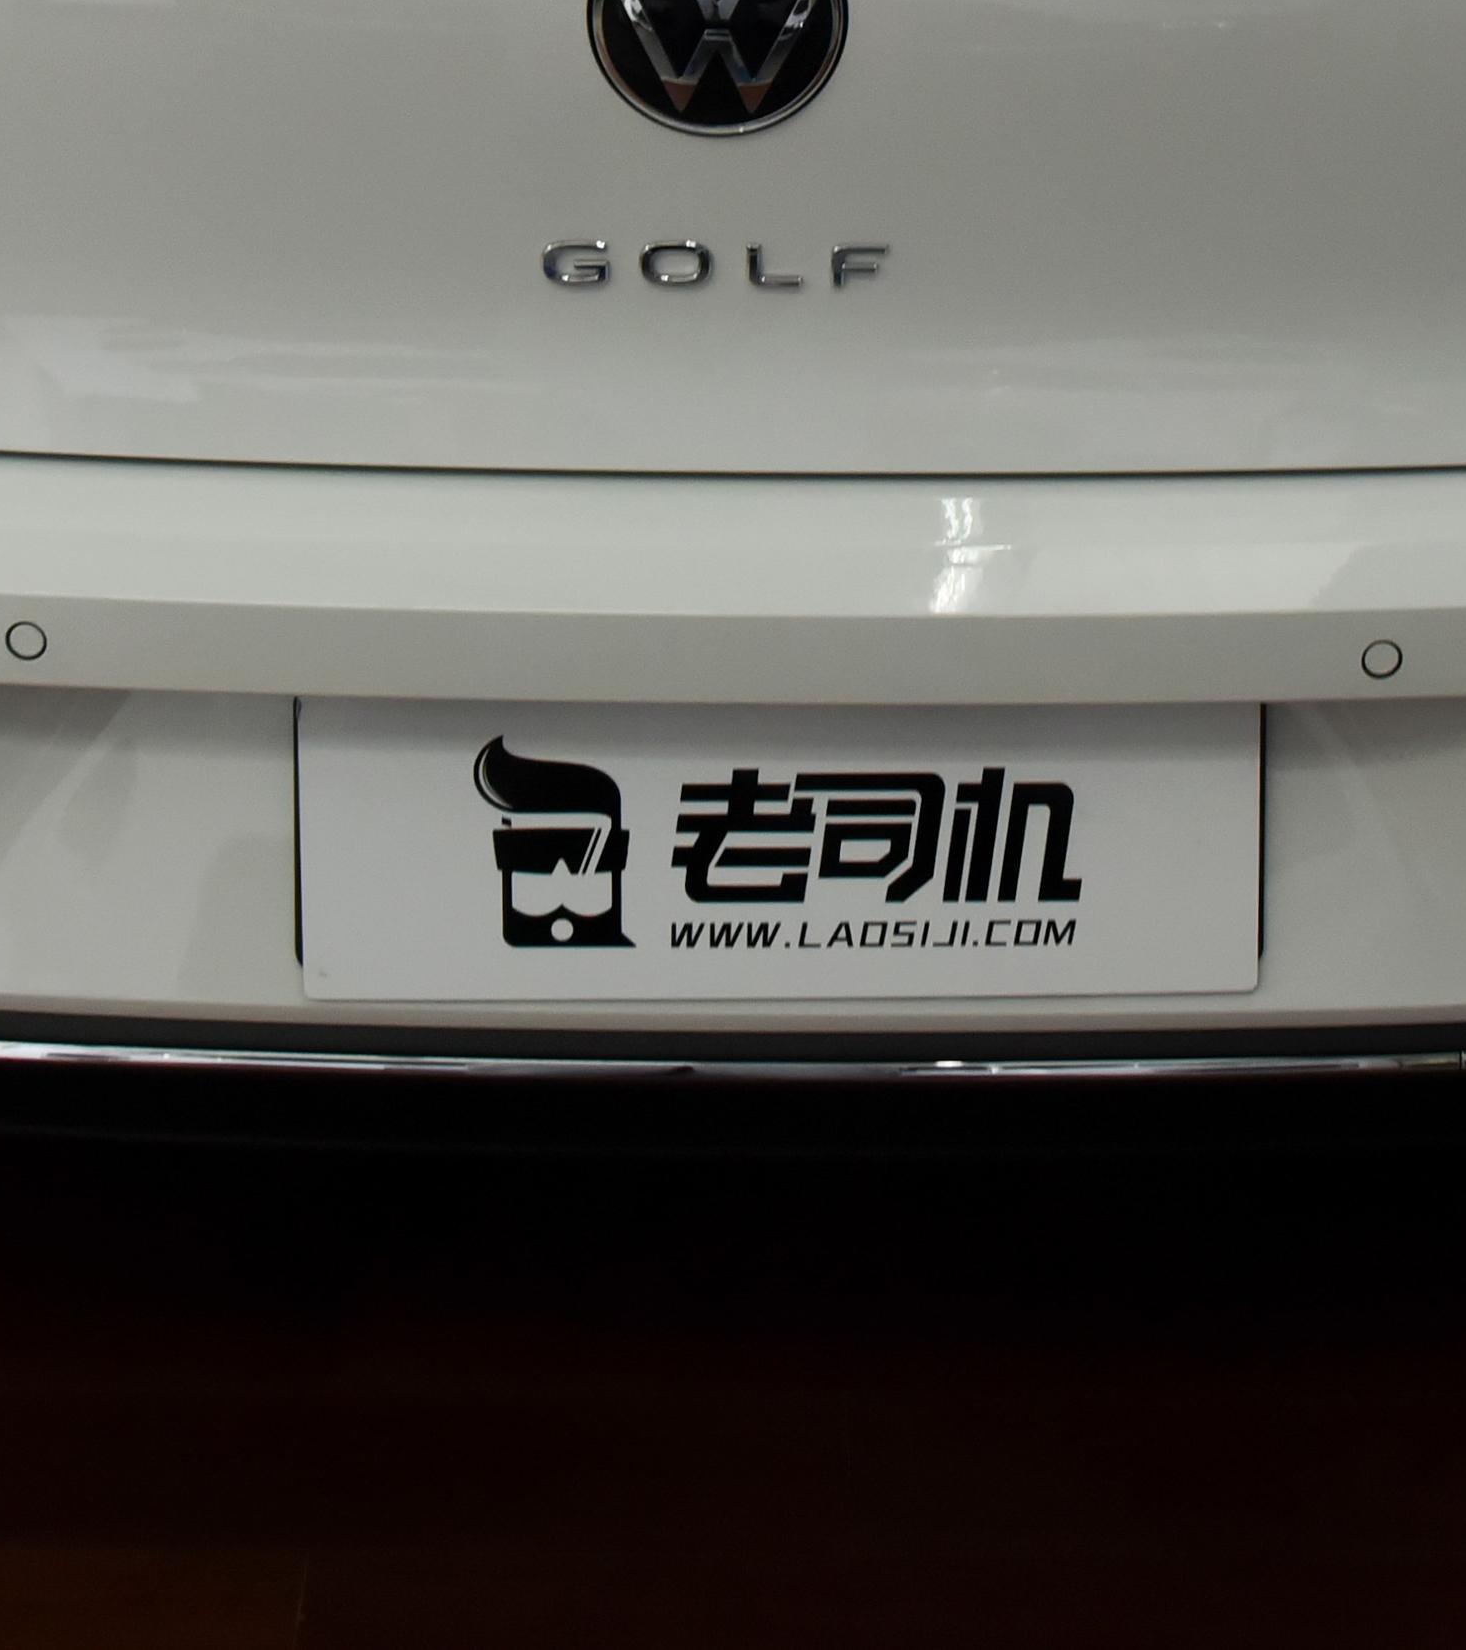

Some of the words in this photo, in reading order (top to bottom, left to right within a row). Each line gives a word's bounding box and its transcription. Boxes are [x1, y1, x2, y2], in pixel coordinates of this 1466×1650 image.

[541, 239, 890, 289] GOLF
[670, 766, 1082, 904] 老司机
[669, 919, 1077, 950] WWW.LAOSIJI.COM
